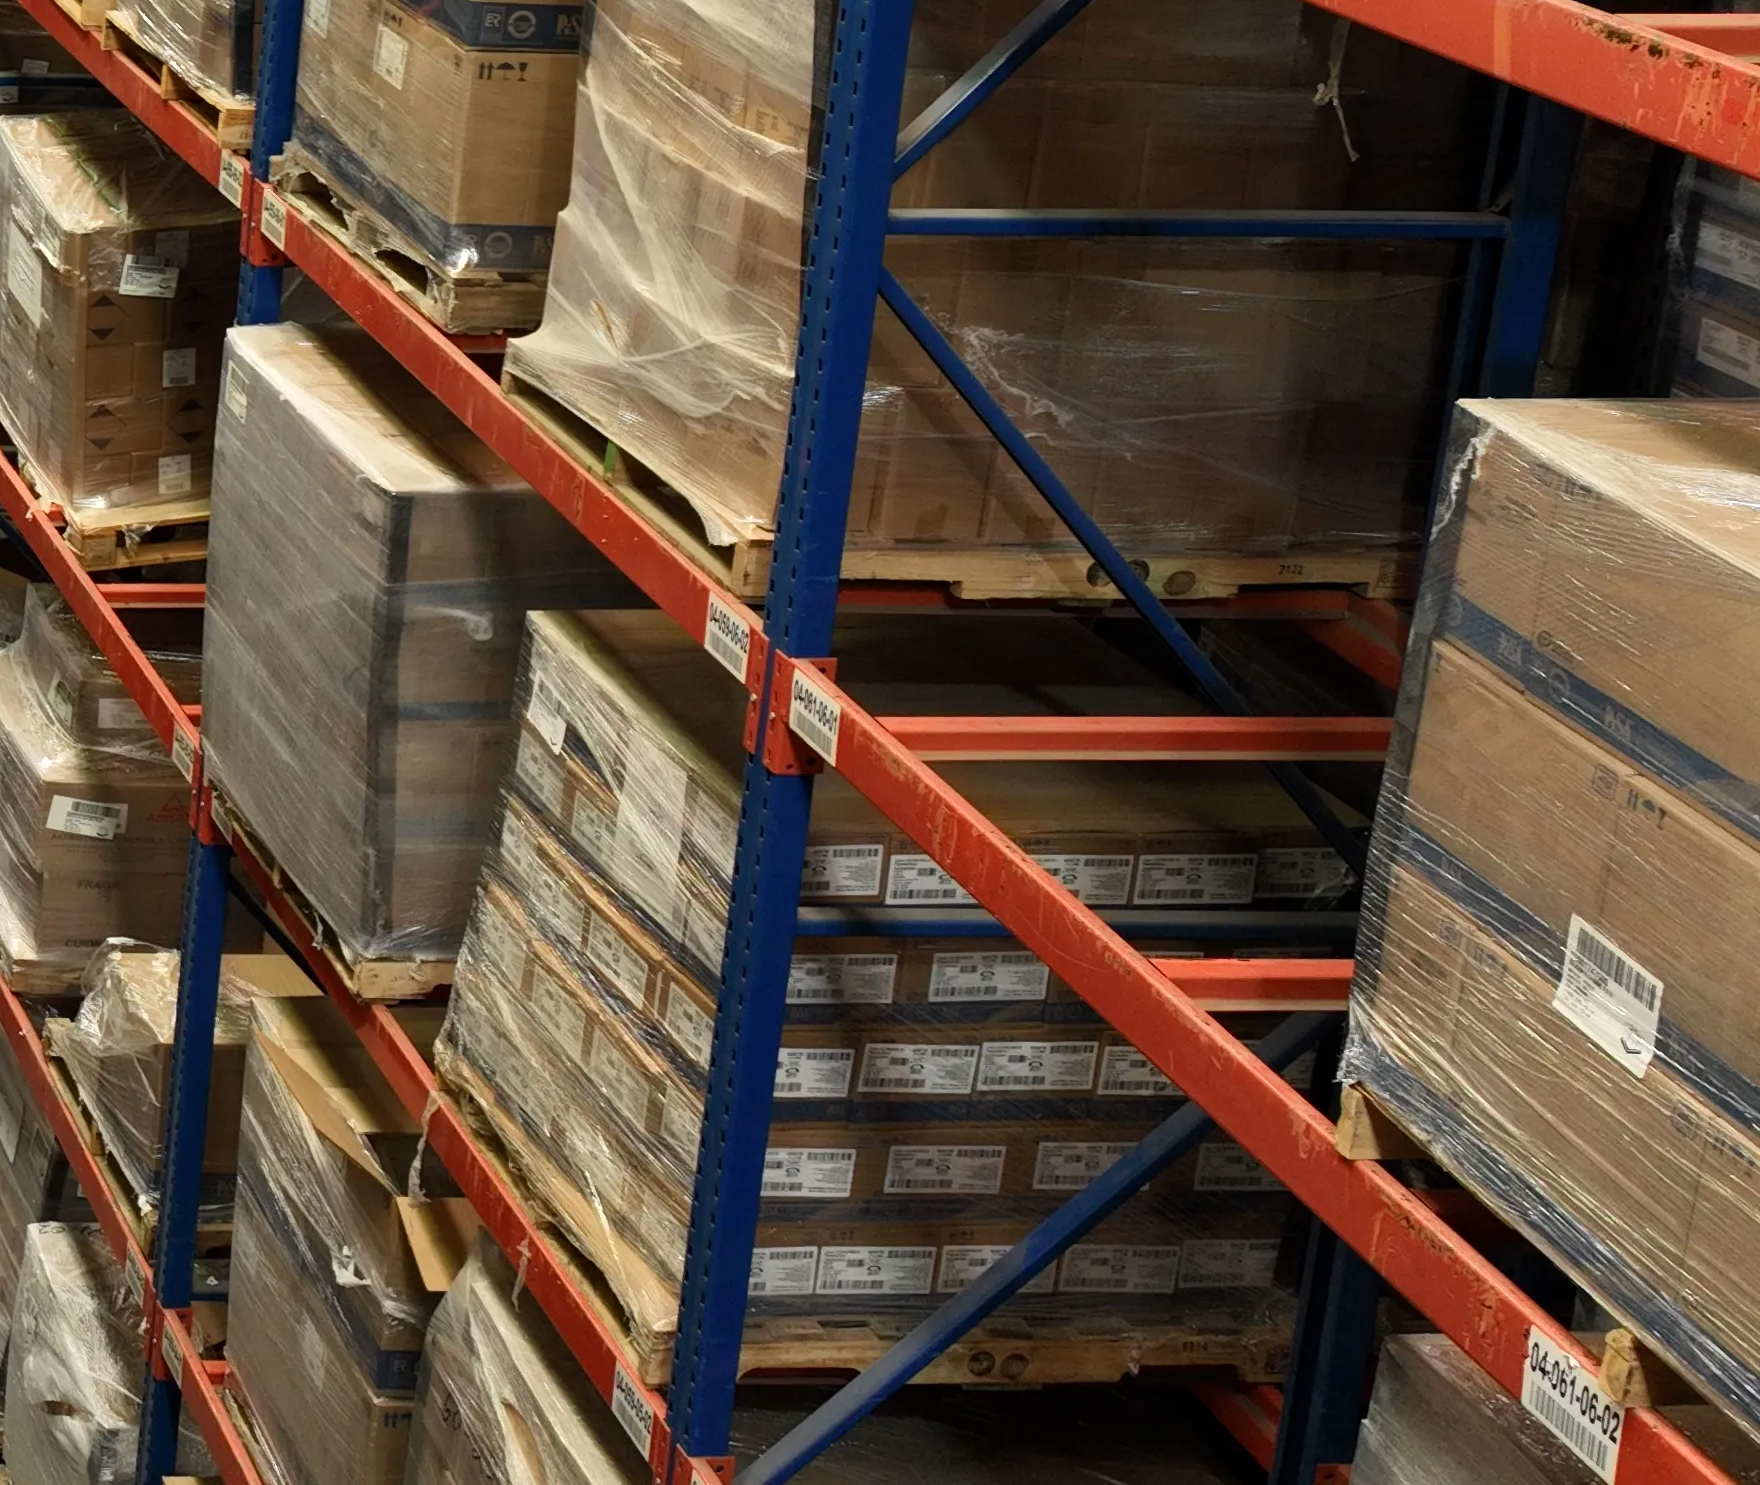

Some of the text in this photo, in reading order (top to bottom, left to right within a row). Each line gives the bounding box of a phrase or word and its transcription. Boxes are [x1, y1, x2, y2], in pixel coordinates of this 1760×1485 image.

[709, 602, 749, 655] 04-059-06-02
[794, 680, 837, 736] 04-061-06-01
[1530, 1341, 1621, 1445] 04-061-06-02
